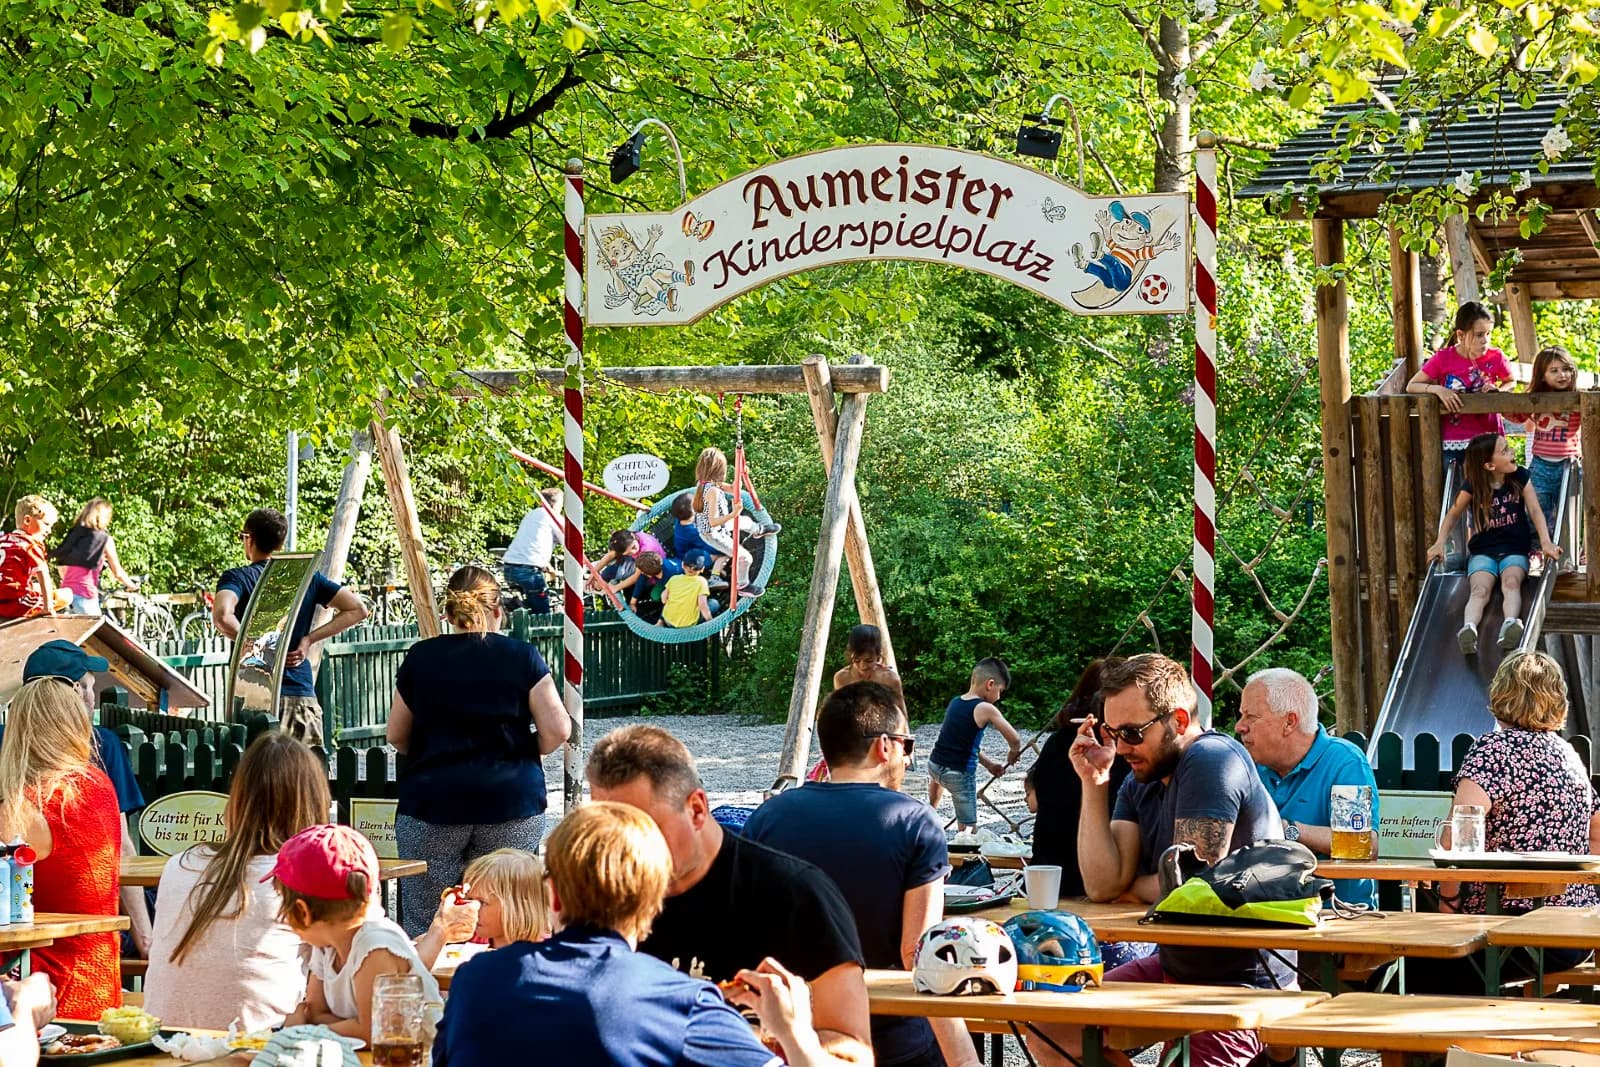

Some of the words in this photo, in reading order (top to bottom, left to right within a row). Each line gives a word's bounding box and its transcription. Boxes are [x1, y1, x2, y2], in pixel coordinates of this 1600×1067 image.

[743, 155, 1014, 230] Aumeister
[702, 212, 1056, 290] Kinderspielplatz
[612, 460, 658, 470] ACHTUNG
[616, 470, 656, 484] Spielende
[623, 483, 651, 493] Kinder
[149, 811, 189, 824] Zutritt
[193, 812, 212, 828] für
[360, 821, 383, 830] Eltern
[1380, 816, 1398, 825] tern
[1401, 816, 1430, 828] haften
[155, 827, 171, 841] bis
[175, 831, 188, 841] zu
[193, 829, 207, 842] 12
[368, 832, 383, 841] ihre
[1381, 828, 1400, 838] ihre
